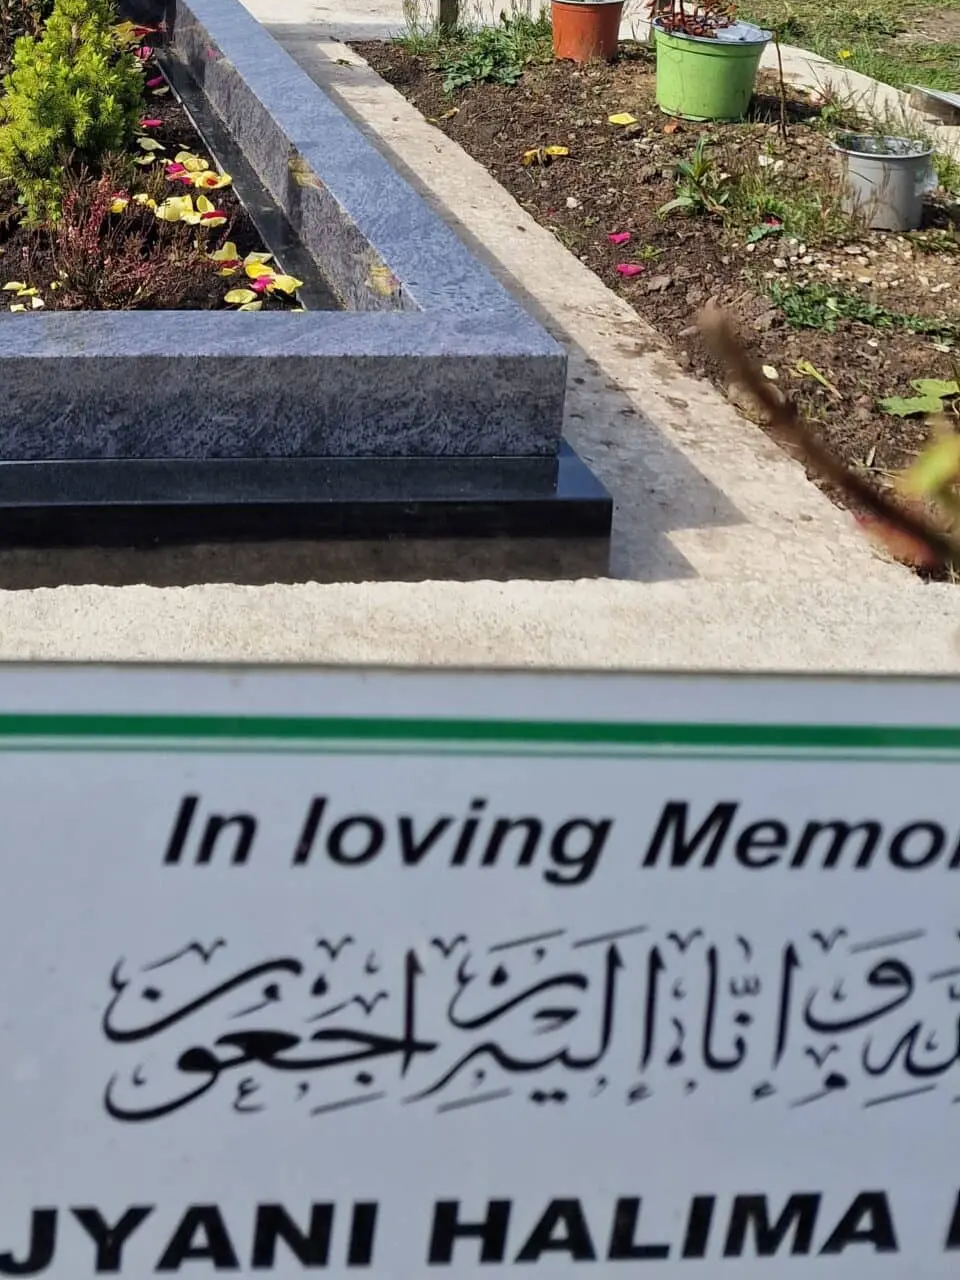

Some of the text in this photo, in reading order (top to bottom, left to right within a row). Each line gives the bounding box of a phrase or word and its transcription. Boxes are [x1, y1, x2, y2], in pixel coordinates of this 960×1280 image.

[162, 795, 259, 866] In
[291, 795, 614, 886] loving
[426, 1190, 900, 1266] HALIMA
